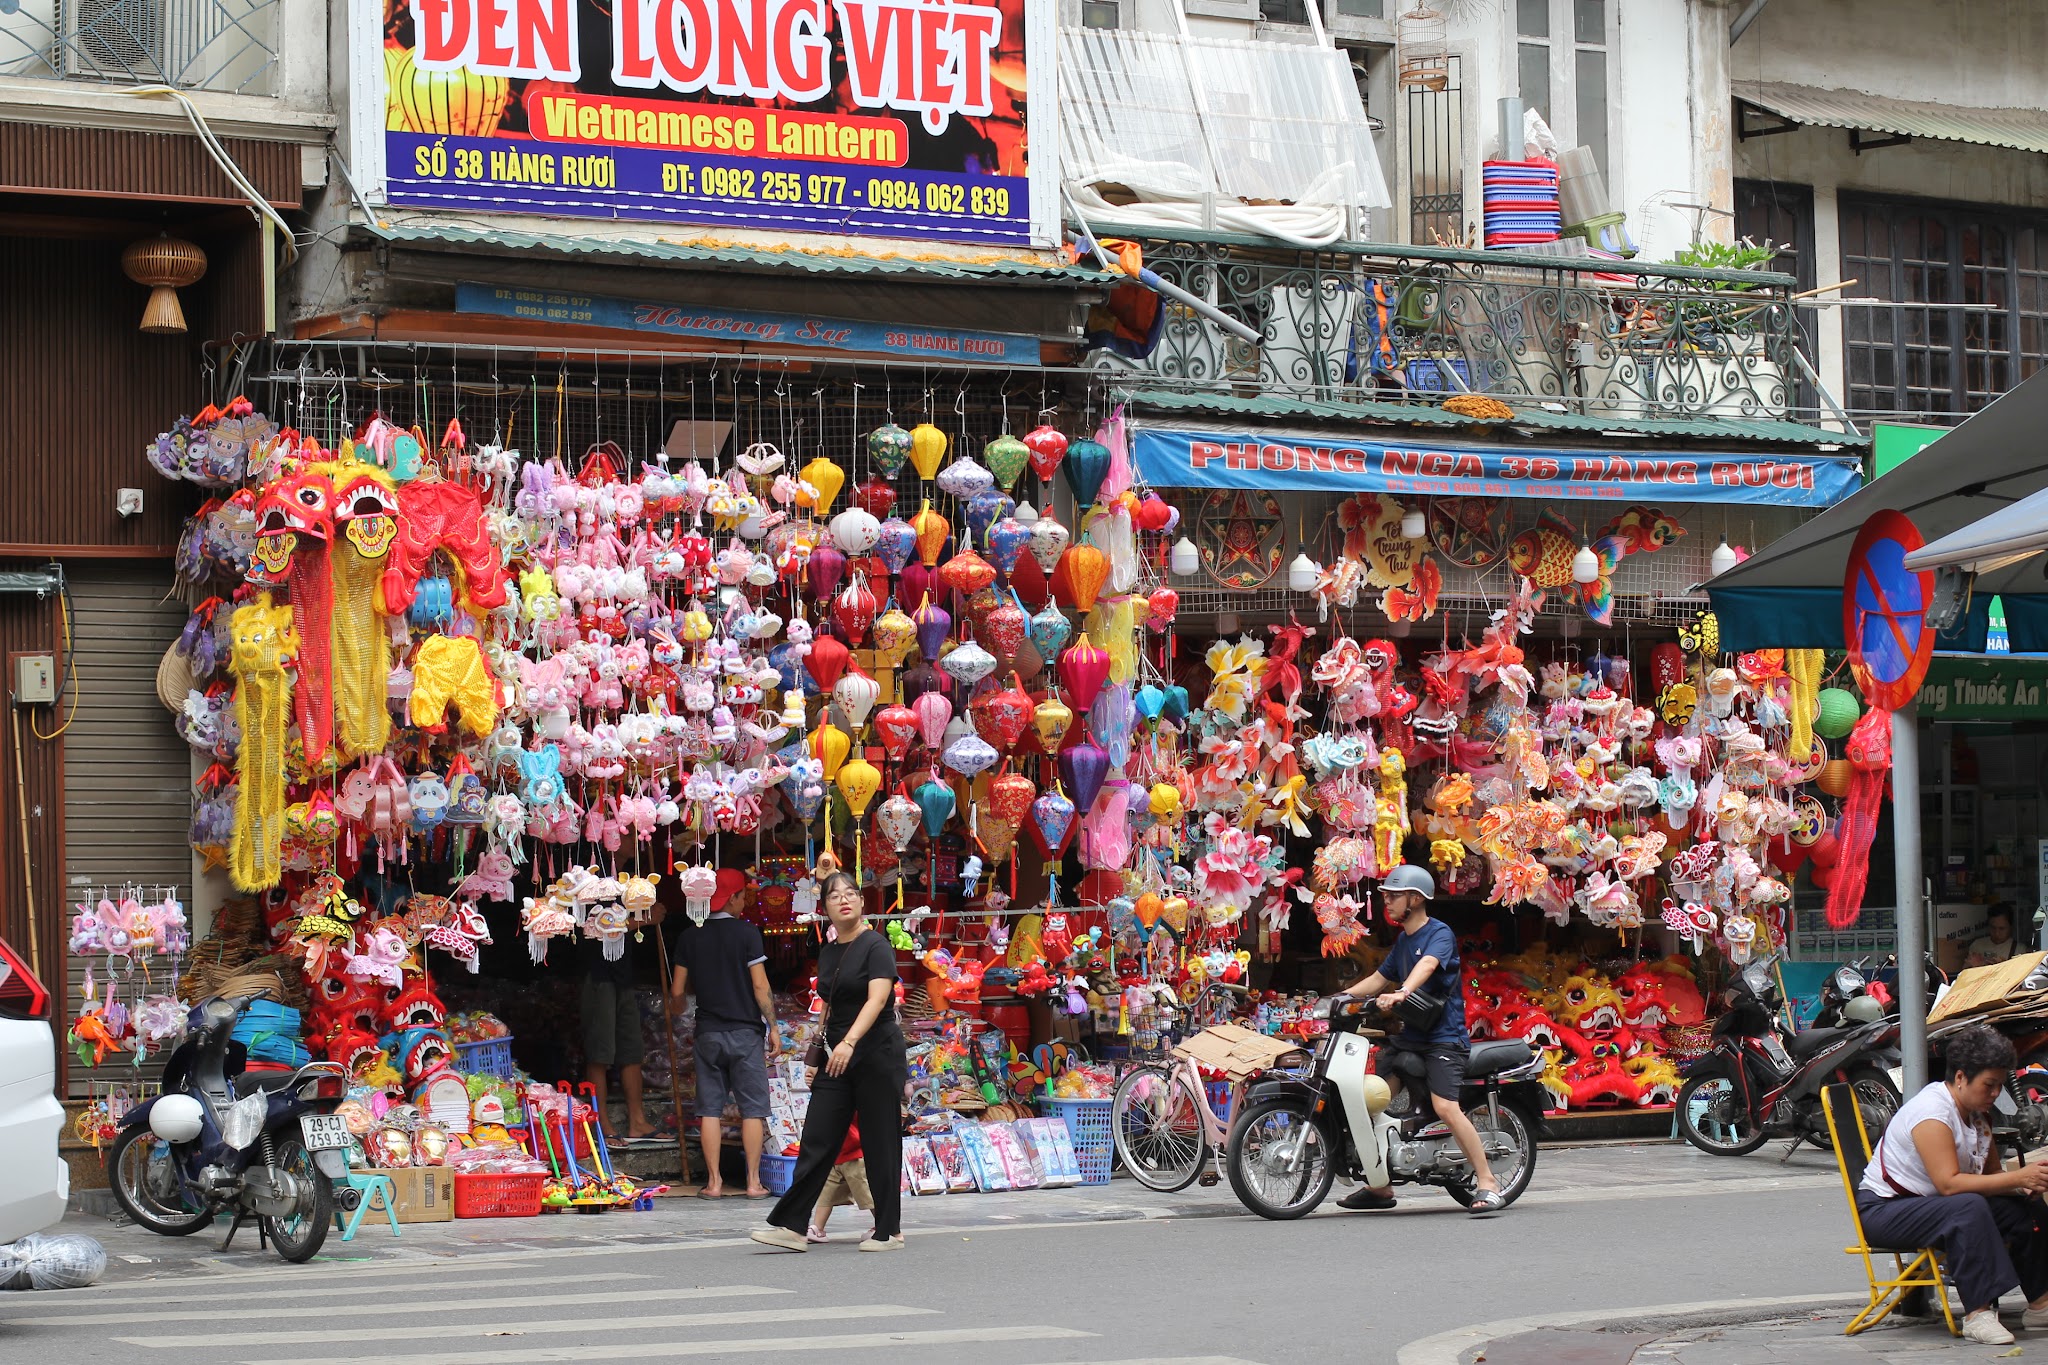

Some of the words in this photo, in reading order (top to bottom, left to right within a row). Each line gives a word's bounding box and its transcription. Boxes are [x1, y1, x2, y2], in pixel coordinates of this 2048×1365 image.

[842, 0, 994, 126] VIỆT
[542, 96, 755, 150] Vietnamese
[766, 114, 897, 162] Lantern
[415, 136, 448, 178] SỐ
[454, 148, 484, 180] 38
[490, 146, 555, 185] HÀNG
[562, 155, 616, 188] RƯƠI
[661, 162, 695, 194] ĐT:
[701, 166, 756, 198] 0982
[761, 171, 802, 201] 255
[808, 175, 847, 205] 977
[868, 179, 920, 210] 0984
[926, 184, 965, 213] 062
[970, 186, 1010, 216] 839
[515, 291, 544, 304] 0982
[571, 297, 592, 308] 977
[515, 305, 544, 317] 0984
[547, 308, 568, 319] 062
[571, 311, 593, 321] 839
[884, 331, 907, 348] 38
[911, 332, 960, 351] HÀNG
[1190, 441, 1368, 474] PHONG
[1381, 449, 1485, 479] NGA
[1500, 456, 1560, 481] 36
[1570, 455, 1699, 486] HÀNG
[1412, 480, 1450, 492] 0979
[1526, 485, 1563, 496] 0393
[1373, 537, 1415, 560] Trung
[1385, 553, 1409, 574] Thu
[1954, 672, 2008, 706] Thuốc
[2013, 679, 2040, 706] An
[310, 1132, 349, 1148] 259.36
